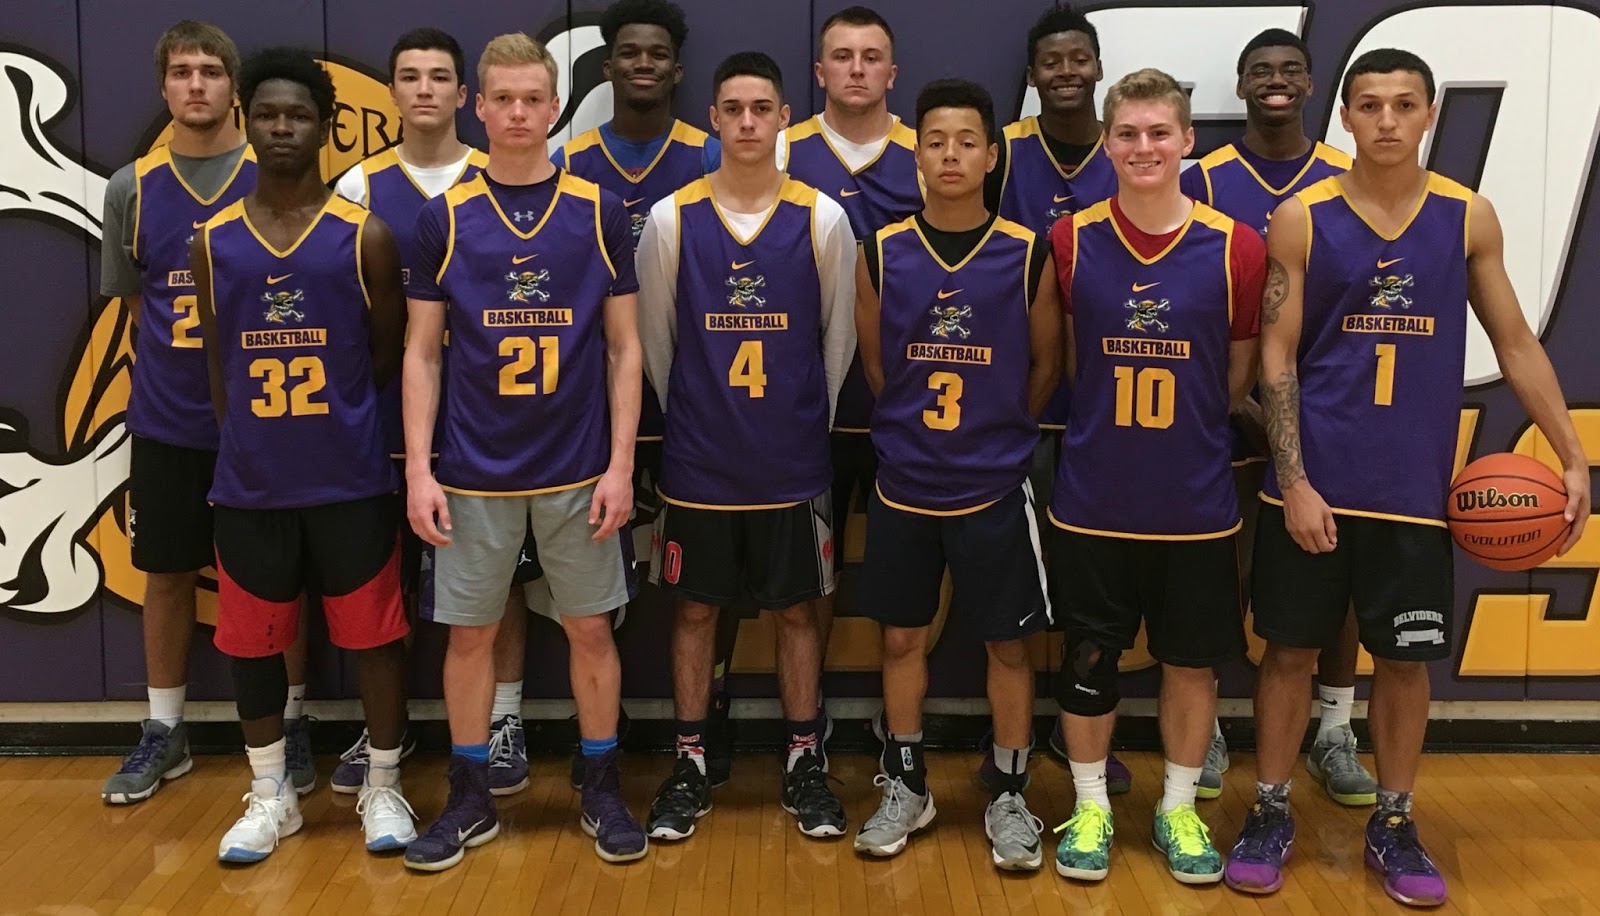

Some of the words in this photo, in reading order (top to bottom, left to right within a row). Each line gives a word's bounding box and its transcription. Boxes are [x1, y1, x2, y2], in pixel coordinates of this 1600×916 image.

[171, 272, 194, 286] BAS
[488, 311, 569, 325] BASKETBALL
[709, 315, 785, 329] BASKETBALL
[1346, 316, 1430, 334] BASKETBALL
[245, 331, 322, 347] BASKETBALL
[1106, 339, 1186, 357] BASKETBALL
[910, 345, 987, 362] BASKETBALL
[498, 335, 560, 396] 21
[728, 340, 767, 398] 4
[1374, 343, 1397, 406] 1
[249, 356, 329, 418] 32
[922, 371, 964, 432] 3
[1114, 366, 1176, 430] 10
[1456, 486, 1539, 513] Wilson
[1464, 528, 1542, 546] EVOLUTION
[1393, 610, 1444, 628] BELVIDERE
